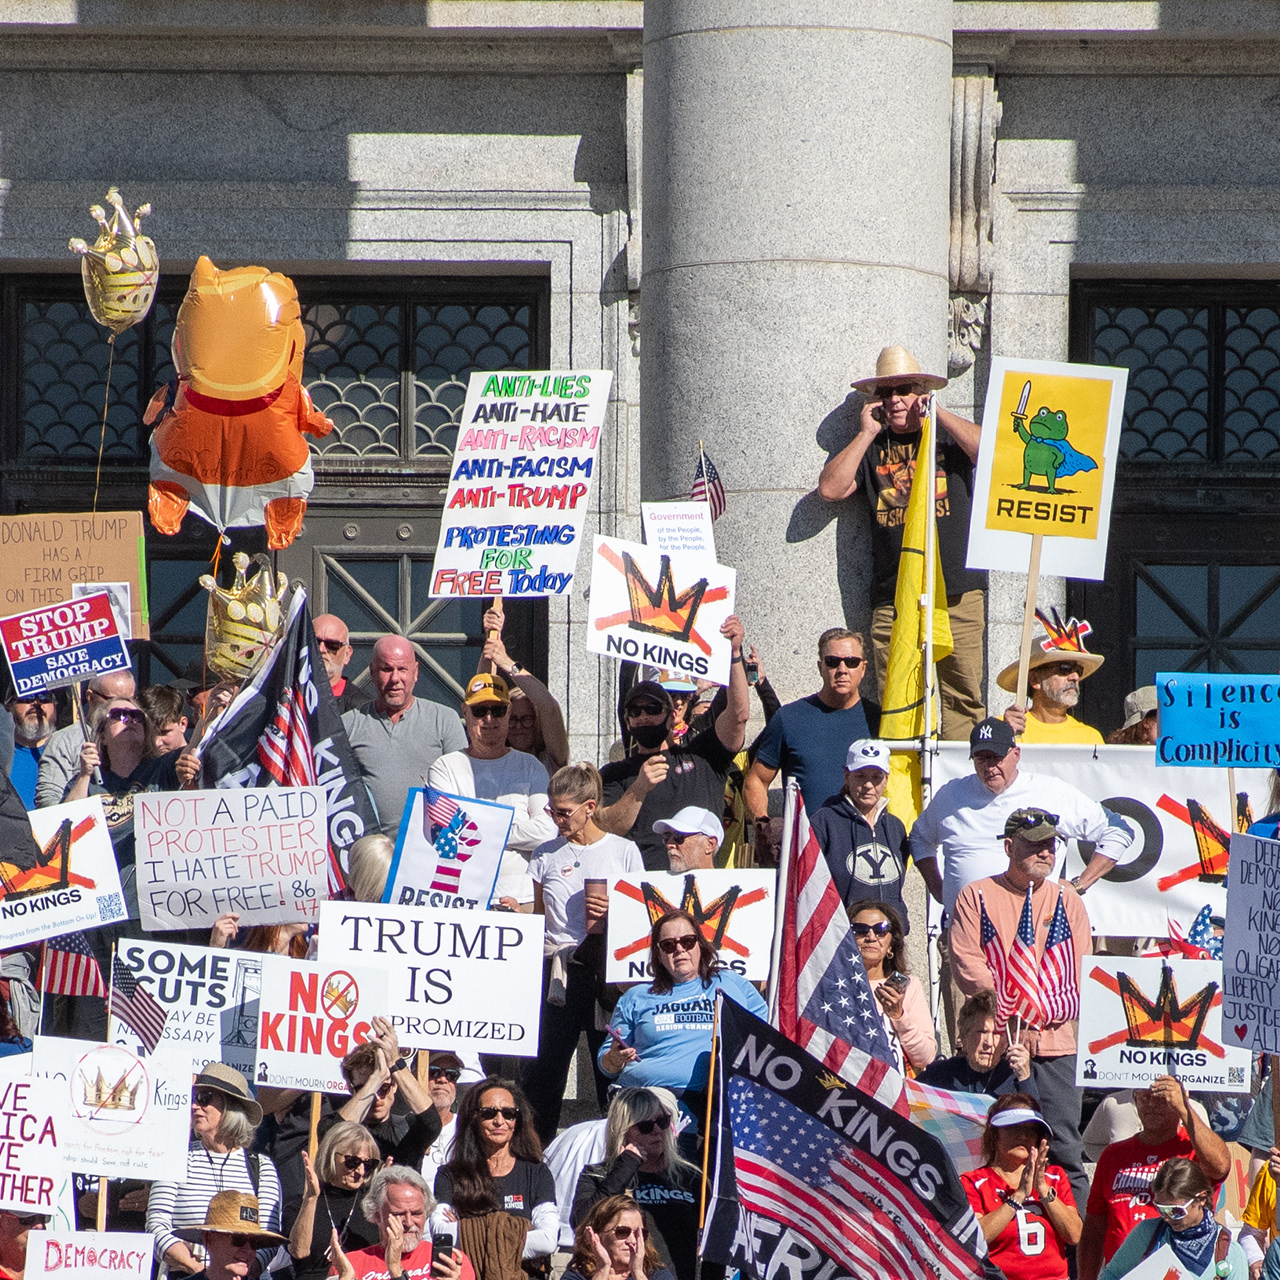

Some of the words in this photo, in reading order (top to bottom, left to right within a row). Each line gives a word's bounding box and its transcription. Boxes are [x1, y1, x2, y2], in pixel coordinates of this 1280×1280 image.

[481, 375, 591, 398] ANTI-LIES
[472, 402, 590, 424] ANTI-HATE
[458, 426, 600, 451] ANTI-RACISM
[452, 456, 593, 480] ANTI-FACISM
[448, 483, 587, 510] ANTI-TRUMP
[649, 512, 704, 521] Government
[997, 498, 1094, 525] RESIST
[2, 520, 63, 544] DONALD
[71, 518, 128, 542] TRUMP
[444, 524, 575, 549] PROTESTING
[43, 547, 69, 562] HAS
[75, 547, 82, 560] A
[480, 548, 533, 569] FOR
[24, 567, 62, 582] FIRM
[68, 566, 104, 581] GRIP
[433, 569, 503, 595] FREE
[508, 565, 573, 594] Today
[6, 588, 24, 603] ON
[32, 588, 64, 603] THIS
[20, 602, 91, 638] STOP
[11, 617, 109, 660] TRUMP
[46, 648, 88, 670] SAVE
[606, 634, 639, 657] NO
[643, 645, 709, 676] KINGS
[1220, 707, 1240, 730] is
[141, 798, 205, 828] NOT
[211, 797, 235, 825] A
[243, 792, 317, 822] PAID
[147, 819, 319, 858] PROTESTER
[144, 861, 165, 884] I
[172, 855, 240, 882] HATE
[237, 849, 326, 878] TRUMP
[149, 889, 204, 918] FOR
[210, 882, 286, 914] FREE!
[291, 880, 316, 899] 86
[2, 902, 28, 919] NO
[30, 889, 82, 912] KINGS
[295, 898, 320, 917] 47
[340, 914, 525, 961] TRUMP
[122, 945, 231, 982] SOME
[405, 966, 454, 1005] IS
[1223, 978, 1278, 1001] LIBERTY
[1120, 1050, 1146, 1064] NO
[1150, 1052, 1207, 1066] KINGS
[732, 1033, 803, 1091] NO
[816, 1088, 946, 1202] KINGS
[1016, 1209, 1046, 1257] 6
[44, 1239, 147, 1274] DEMOCRACY
